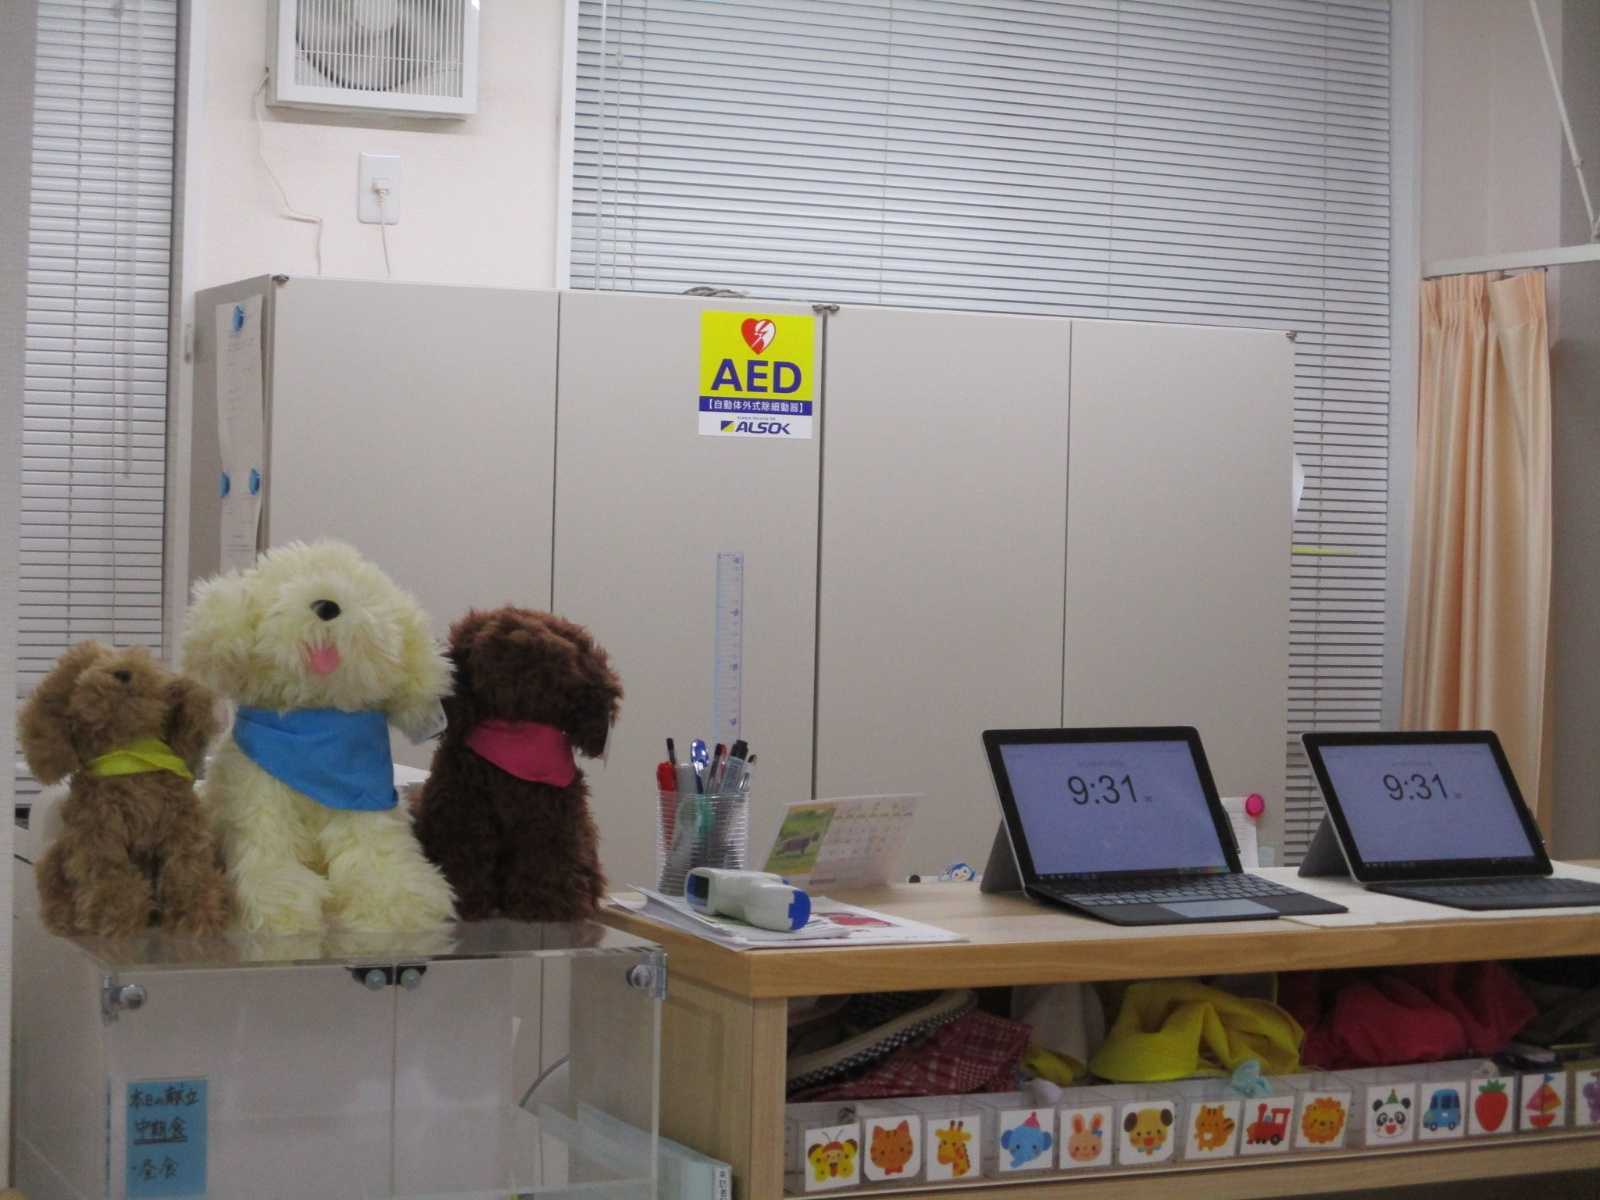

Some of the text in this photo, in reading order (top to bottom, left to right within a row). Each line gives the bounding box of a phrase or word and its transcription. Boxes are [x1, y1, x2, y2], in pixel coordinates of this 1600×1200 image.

[710, 358, 802, 394] AED
[735, 421, 791, 435] ALSOK
[1067, 773, 1137, 805] 9:31
[1382, 773, 1448, 801] 9:31
